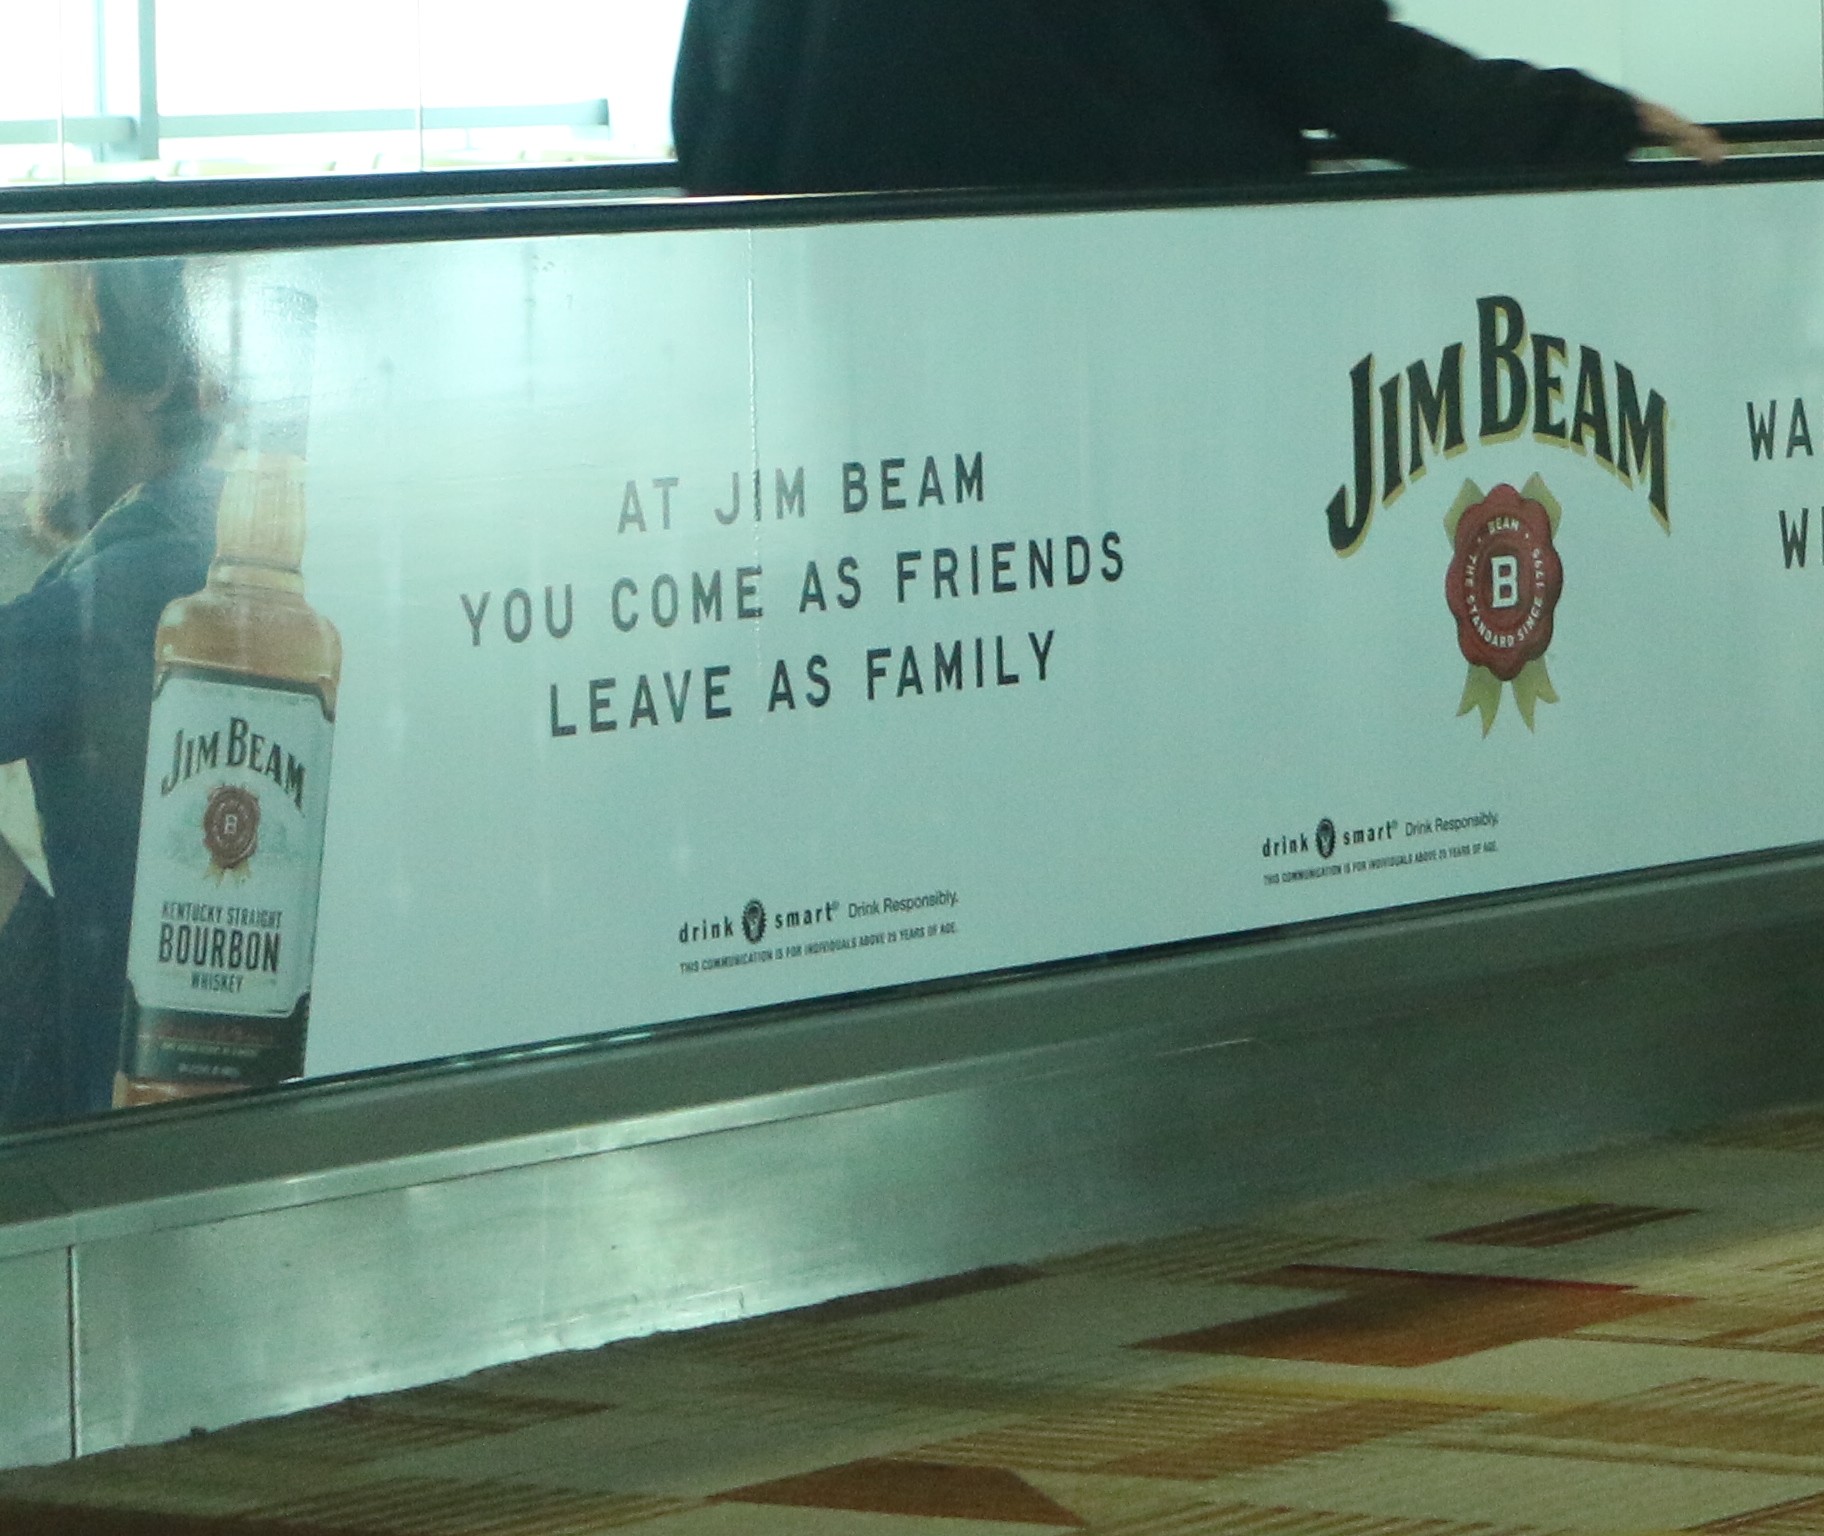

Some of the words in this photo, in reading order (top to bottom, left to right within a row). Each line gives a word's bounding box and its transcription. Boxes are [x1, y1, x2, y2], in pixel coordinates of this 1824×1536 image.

[1325, 351, 1468, 558] JIM
[1476, 294, 1671, 537] BEAM
[617, 476, 679, 534] AT
[714, 467, 805, 525] JIM
[842, 451, 984, 514] BEAM
[460, 583, 573, 647] YOU
[611, 565, 764, 633] COME
[799, 556, 862, 613] AS
[896, 531, 1124, 604] FRIENDS
[1490, 555, 1519, 608] B
[550, 665, 732, 738] LEAVE
[767, 655, 831, 712] AS
[866, 629, 1055, 701] FAMILY
[161, 728, 219, 798] JIM
[227, 716, 306, 810] BEAM
[1262, 833, 1309, 857] drink
[1405, 820, 1432, 837] Drink
[162, 901, 222, 924] KENTUCKY
[679, 916, 734, 944] drink
[849, 901, 879, 919] Drink
[883, 888, 959, 913] Responsibly.
[159, 922, 281, 973] BOURBON
[191, 970, 244, 993] WHISKEY
